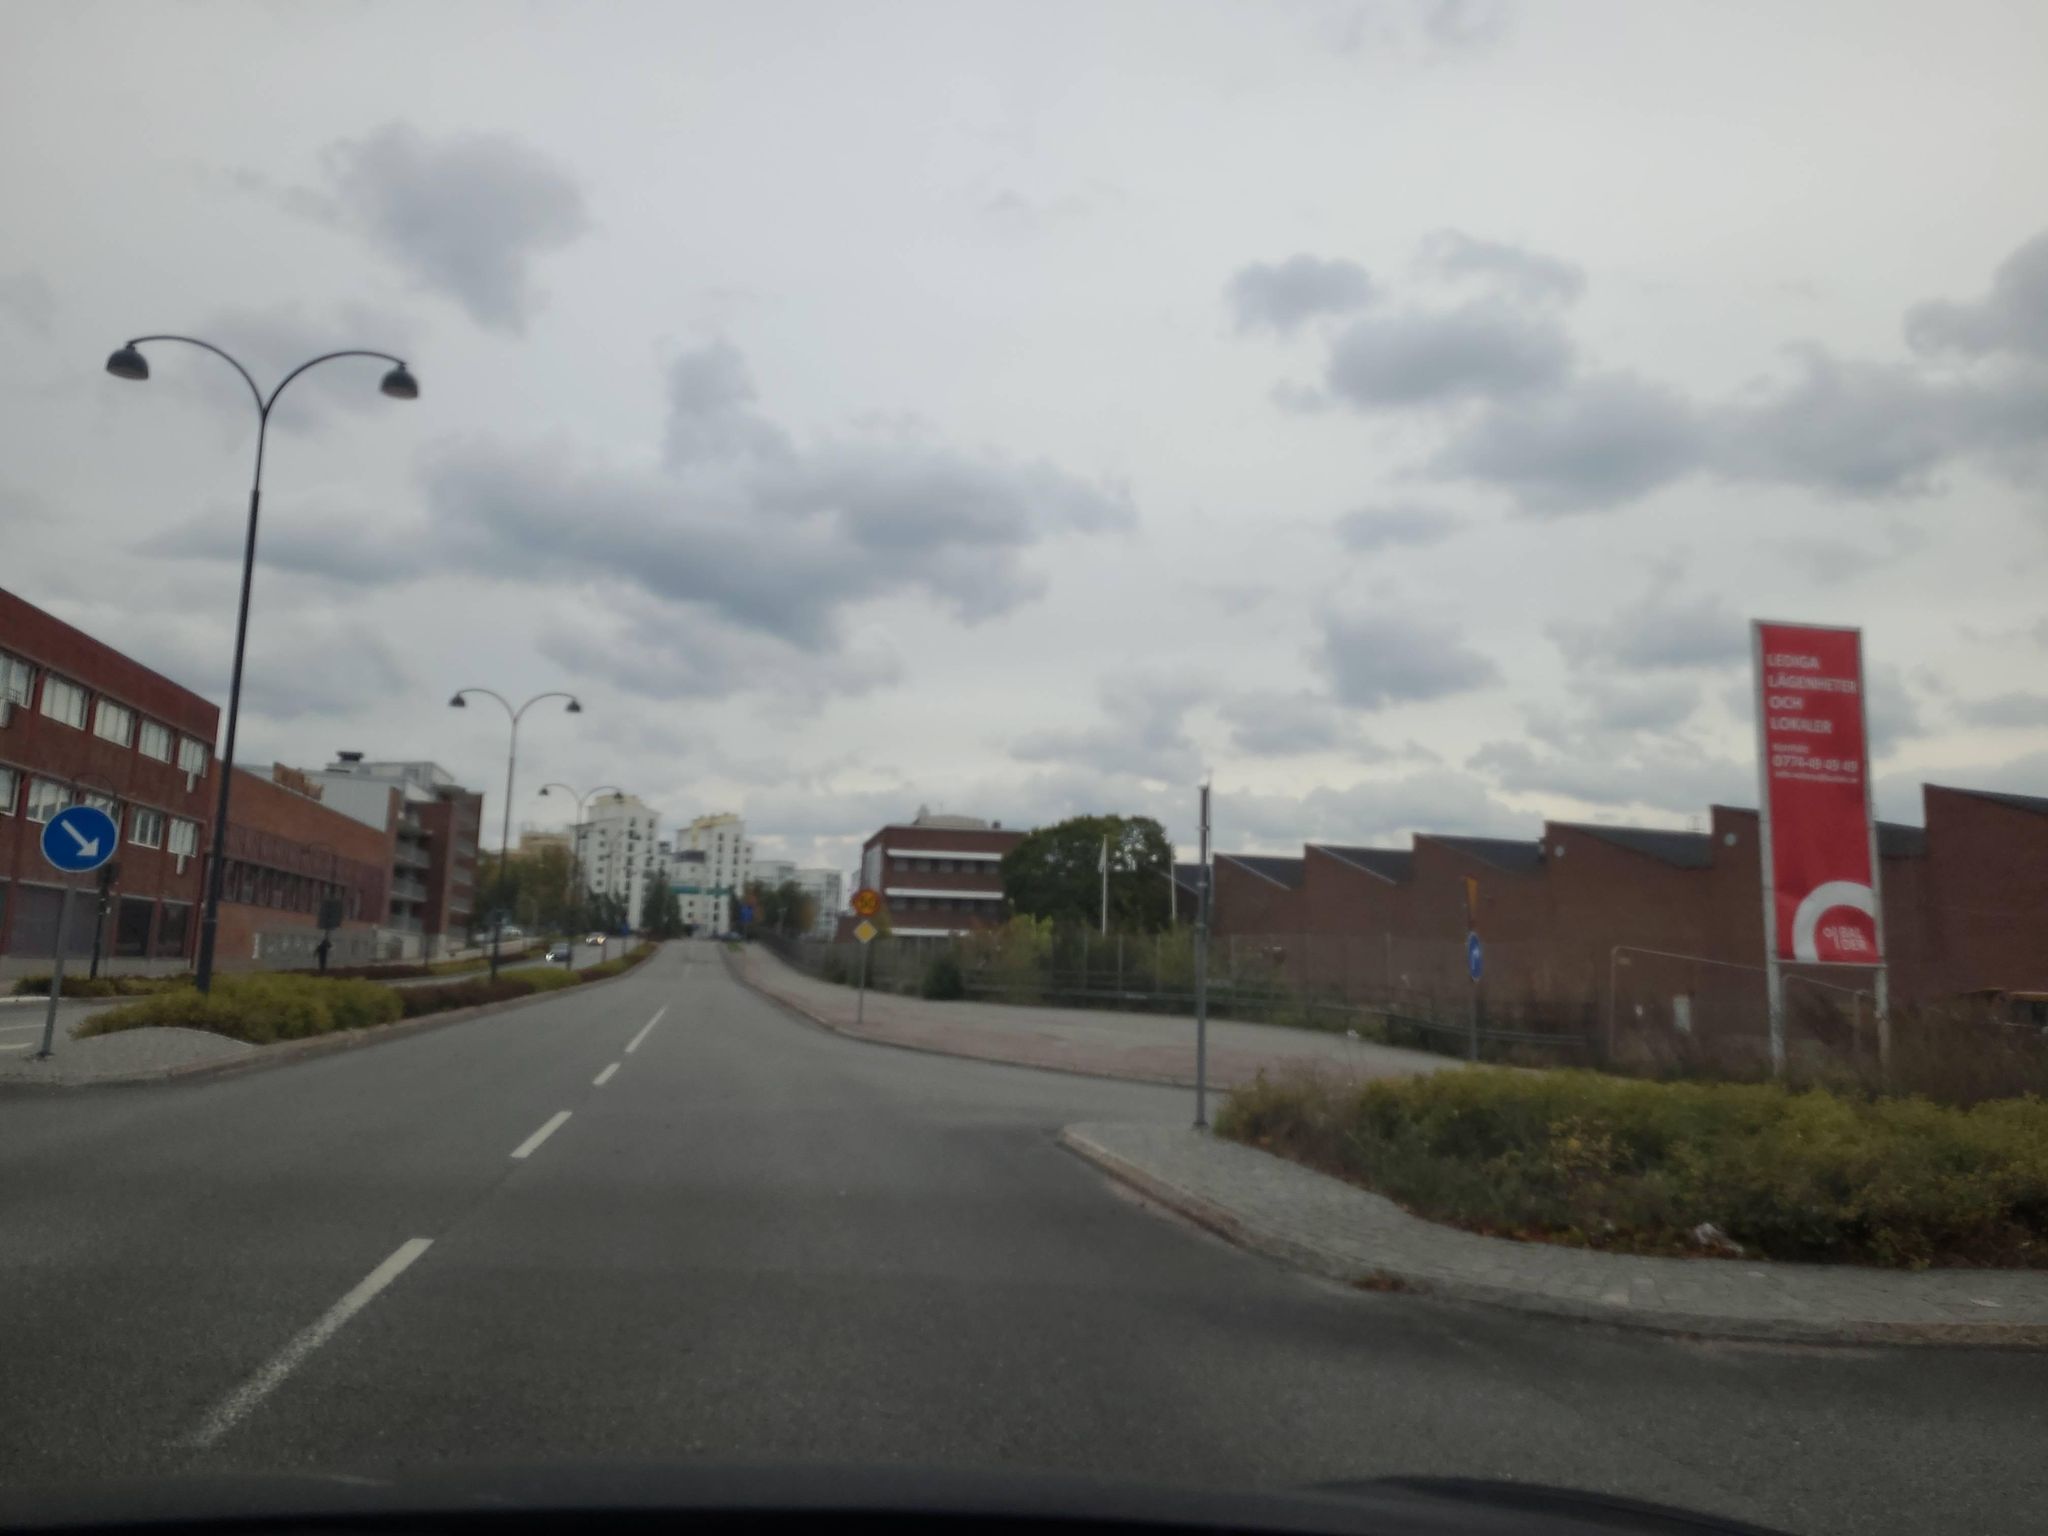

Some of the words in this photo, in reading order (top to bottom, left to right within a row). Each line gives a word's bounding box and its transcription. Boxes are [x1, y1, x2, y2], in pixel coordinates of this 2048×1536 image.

[1766, 654, 1821, 670] LEDIGA
[1768, 672, 1857, 694] LÄGENHETER
[1769, 696, 1804, 710] OCH
[1770, 717, 1832, 733] LOKALER
[1840, 938, 1868, 951] DER
